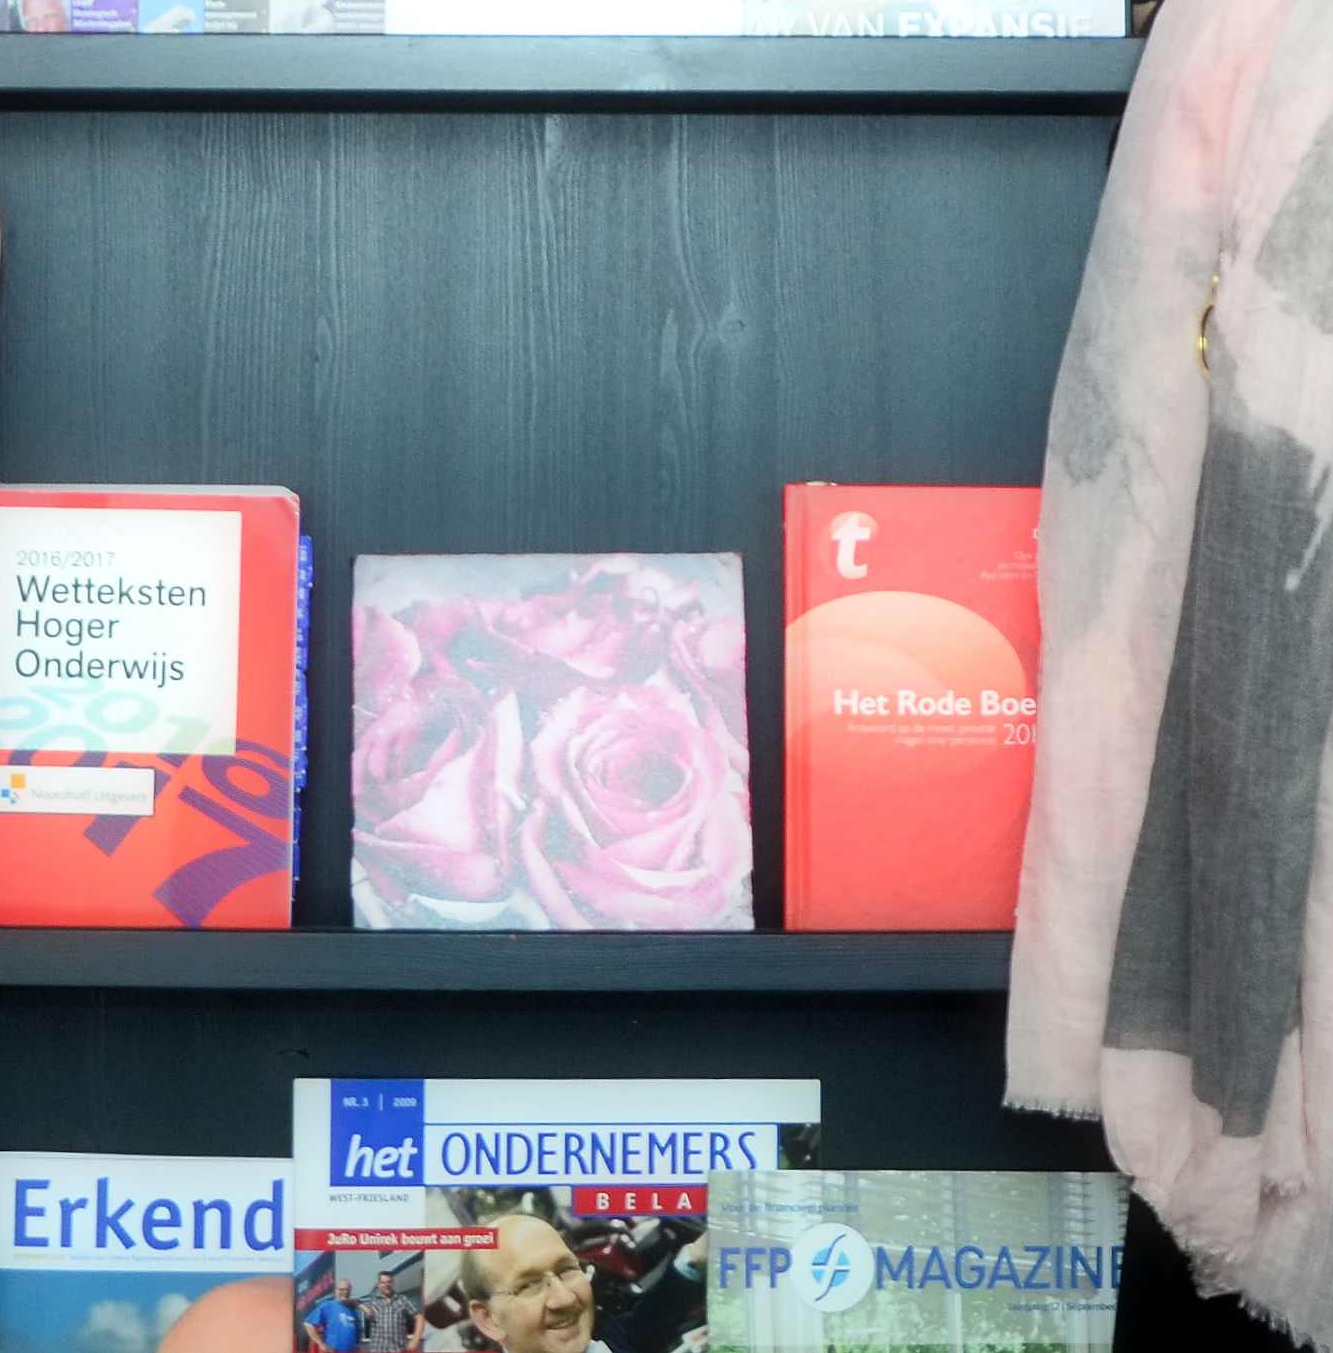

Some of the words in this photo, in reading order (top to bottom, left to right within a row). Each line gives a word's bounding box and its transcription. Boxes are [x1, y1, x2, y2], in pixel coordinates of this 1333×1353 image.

[16, 550, 115, 568] 2016/2017
[16, 575, 207, 607] Wetteksten
[16, 610, 120, 646] Hoger
[15, 649, 185, 688] Onderwijs
[834, 689, 889, 715] Het
[898, 690, 972, 716] Rode
[981, 690, 1037, 716] Boe
[344, 1133, 418, 1178] het
[441, 1131, 756, 1176] ONDERNEMERS
[13, 1176, 284, 1251] Erkend
[401, 1233, 437, 1245] bouwt
[441, 1235, 461, 1244] aan
[464, 1232, 494, 1247] groei
[719, 1247, 792, 1289] FFP
[876, 1245, 1125, 1289] MAGAZINE
